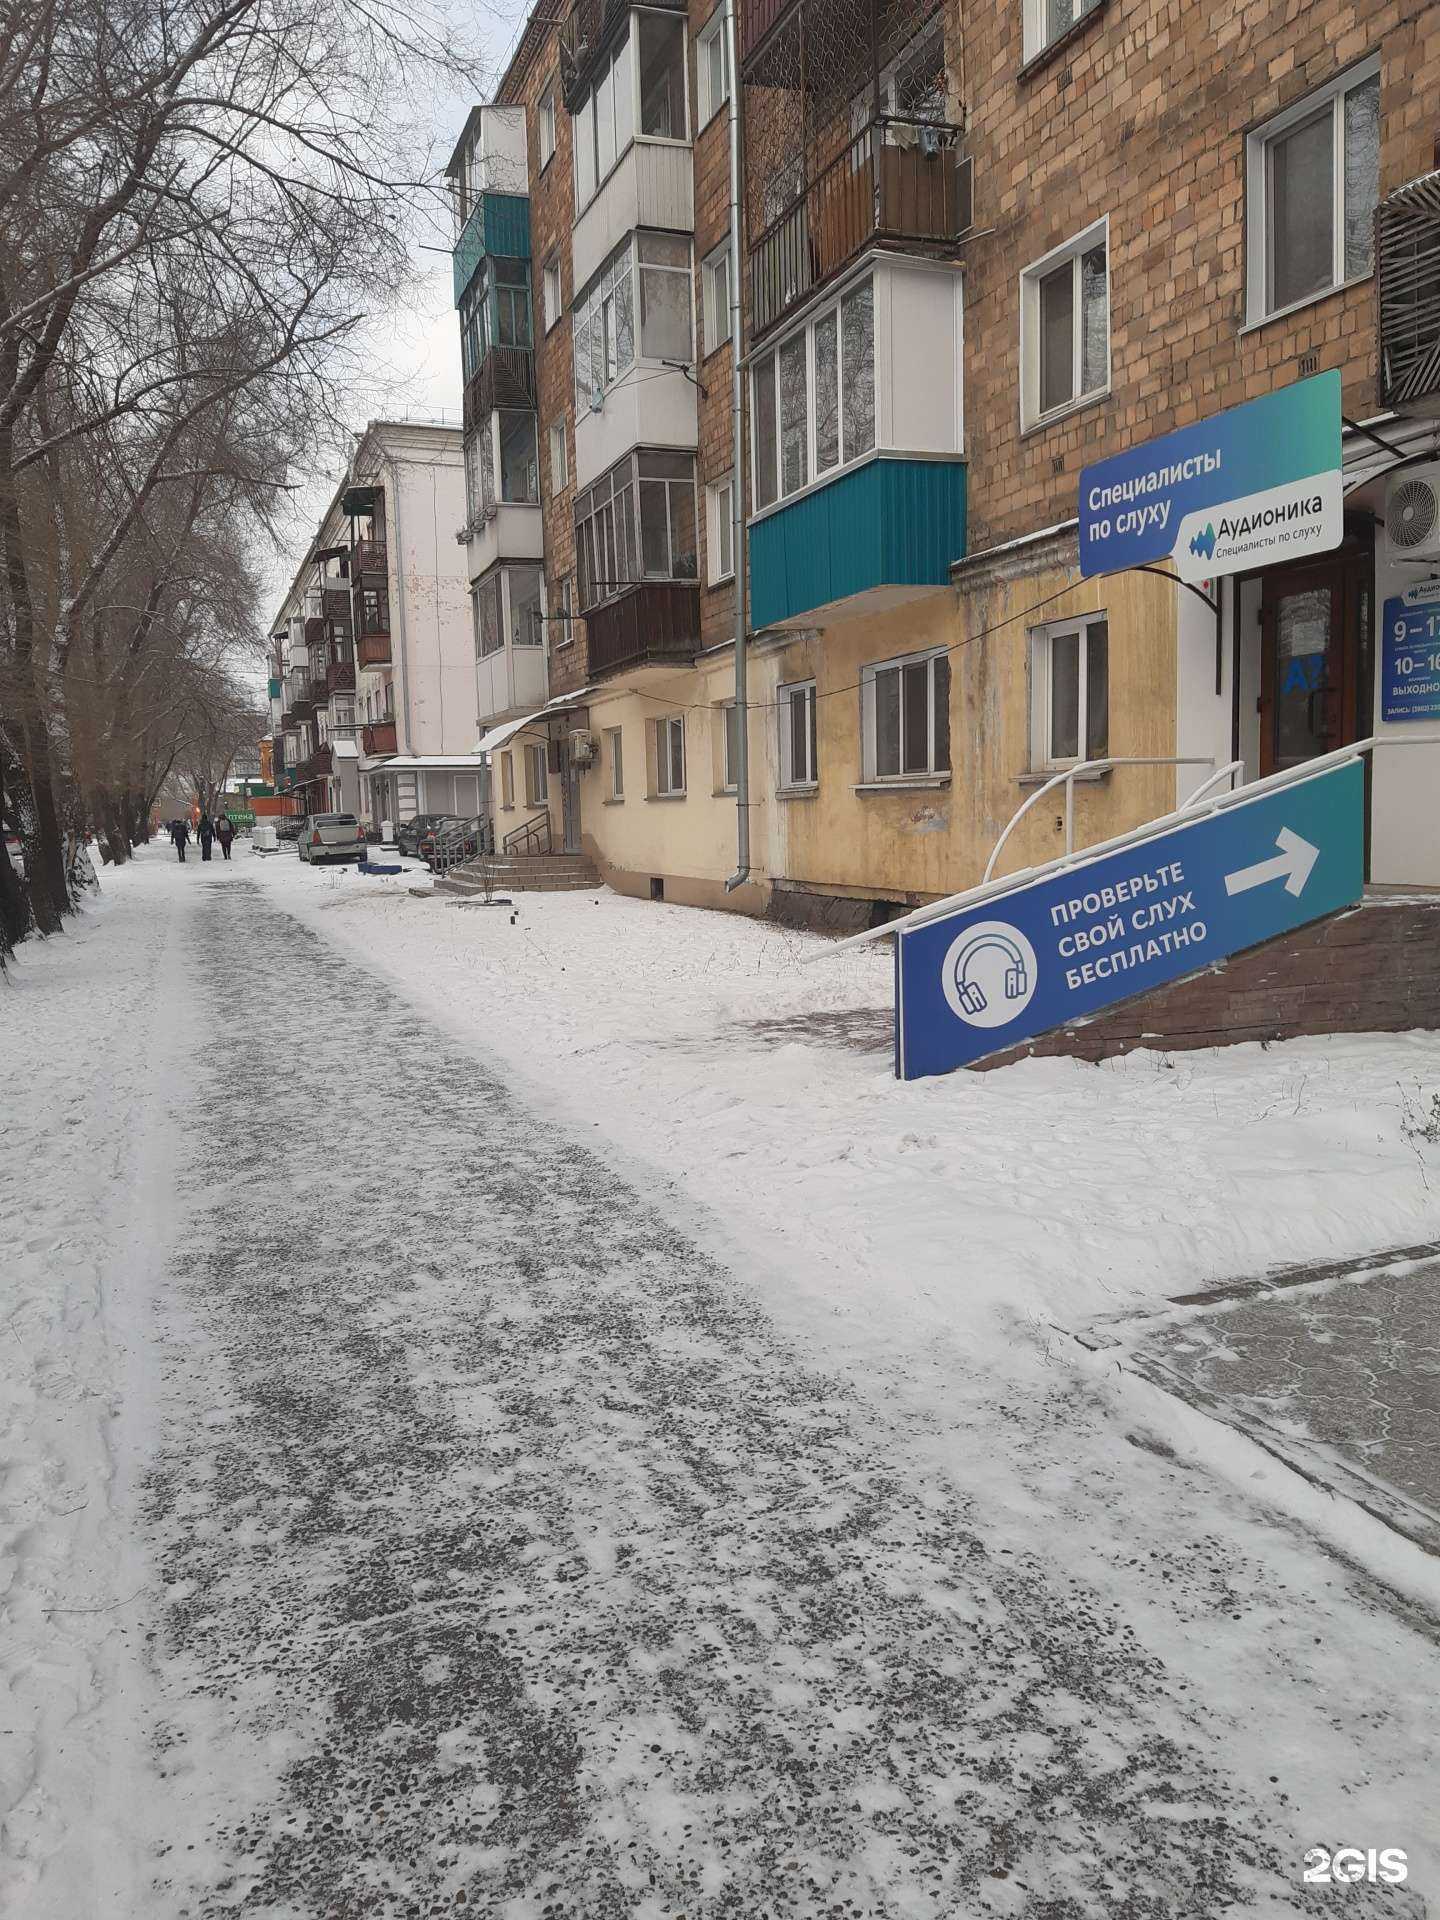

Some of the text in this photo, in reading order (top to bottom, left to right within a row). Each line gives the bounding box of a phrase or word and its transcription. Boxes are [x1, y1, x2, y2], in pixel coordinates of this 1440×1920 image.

[1088, 449, 1222, 512] Специалисты
[1088, 499, 1172, 542] по слуху
[1216, 523, 1323, 560] Специалисты по слуху
[1217, 494, 1323, 540] Аудионика
[1050, 861, 1185, 927] ПРОВЕРЬТЕ
[1057, 891, 1196, 959] СВОЙ СЛУХ
[1065, 920, 1207, 990] БЕСПЛАТНО
